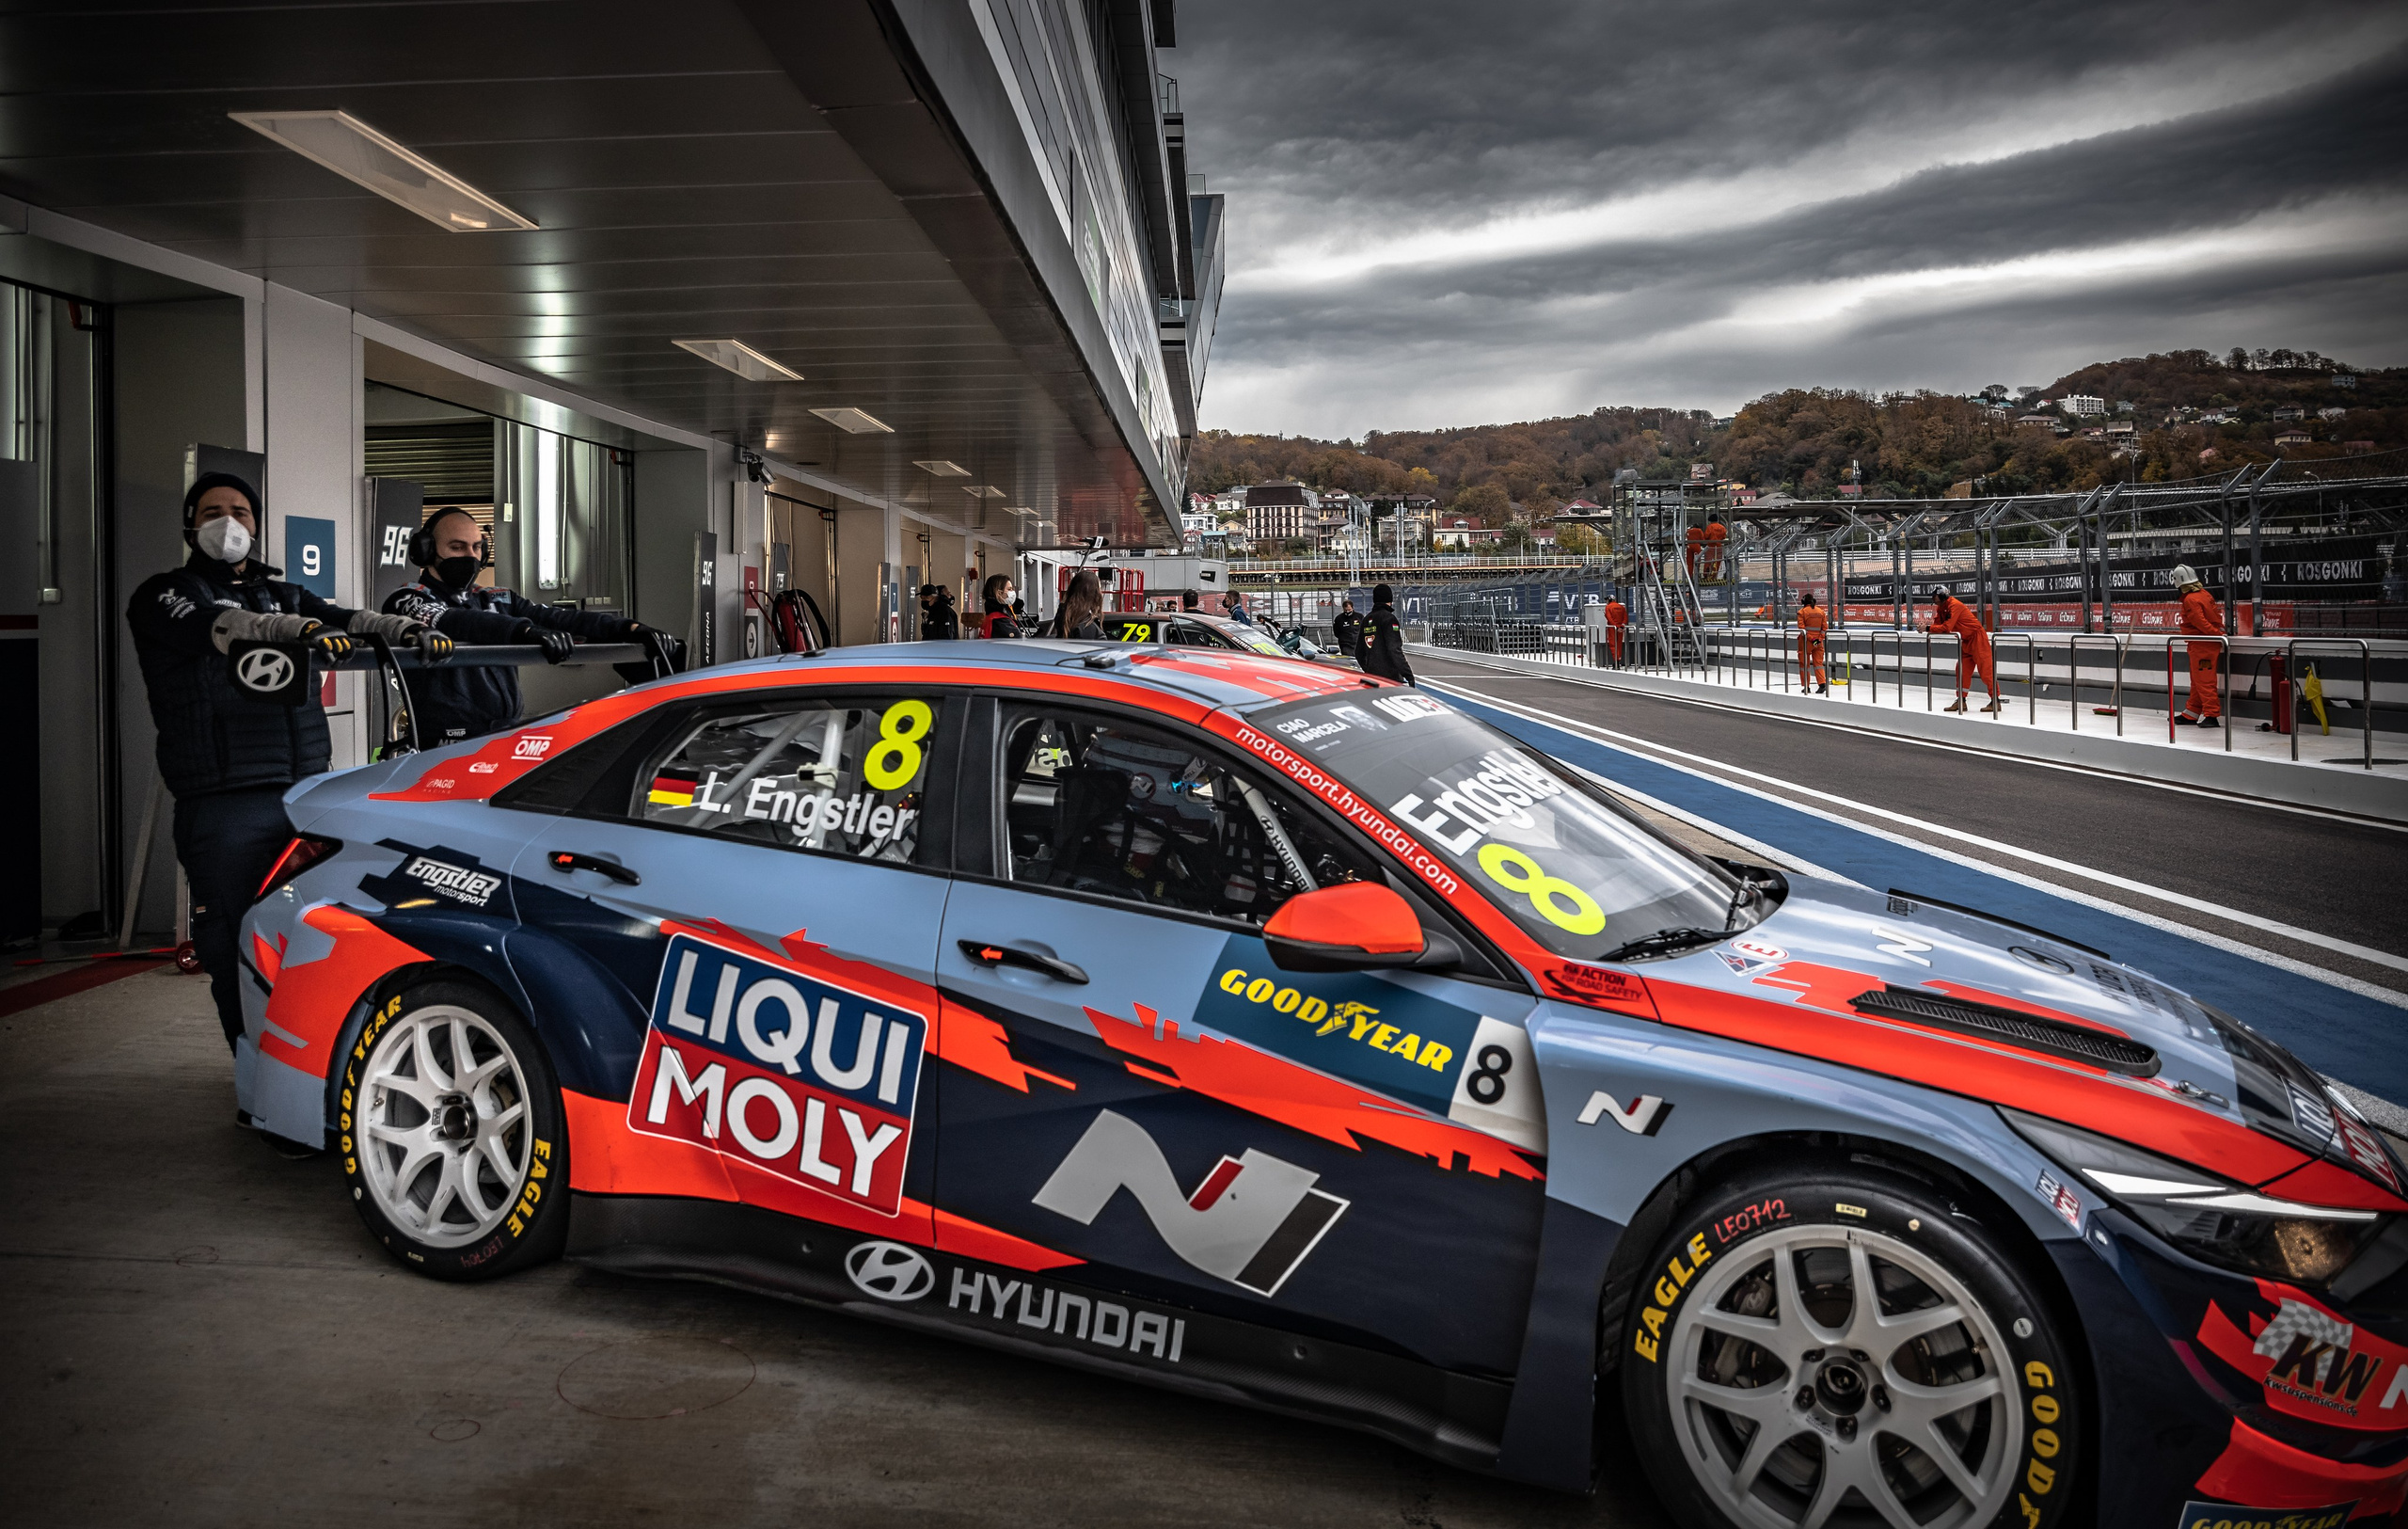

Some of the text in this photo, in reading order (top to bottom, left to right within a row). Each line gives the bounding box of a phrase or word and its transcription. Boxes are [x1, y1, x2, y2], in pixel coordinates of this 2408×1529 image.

[302, 544, 321, 577] 9
[380, 525, 414, 570] 96
[702, 561, 714, 586] 96
[2297, 561, 2363, 581] ROSGONKI
[1563, 594, 1599, 611] VTB
[1121, 623, 1151, 643] 79
[513, 737, 553, 758] OMP
[863, 699, 933, 790] 8
[1275, 718, 1310, 734] CIAO
[1291, 721, 1352, 743] MARCELA
[433, 778, 455, 789] PAGID
[699, 771, 733, 814] L.
[744, 777, 916, 841] Engstler
[1235, 727, 1459, 895] motorsport.hyundai.com
[405, 856, 502, 899] Engstler
[434, 884, 489, 908] motorsport
[1477, 843, 1607, 936] 8
[1576, 978, 1604, 992] ROAD
[1604, 983, 1643, 1000] SAFETY
[1580, 967, 1627, 987] ACTION
[666, 948, 911, 1107] LIQUI
[1465, 1043, 1513, 1106] 8
[646, 1045, 904, 1198] MOLY
[506, 1137, 552, 1238] EAGLE
[1714, 1199, 1792, 1244] LEO712
[948, 1266, 1186, 1362] HYUNDAI
[1634, 1232, 1713, 1363] EAGLE
[2266, 1330, 2384, 1406] KW
[2262, 1375, 2359, 1417] kwsuspensions.de
